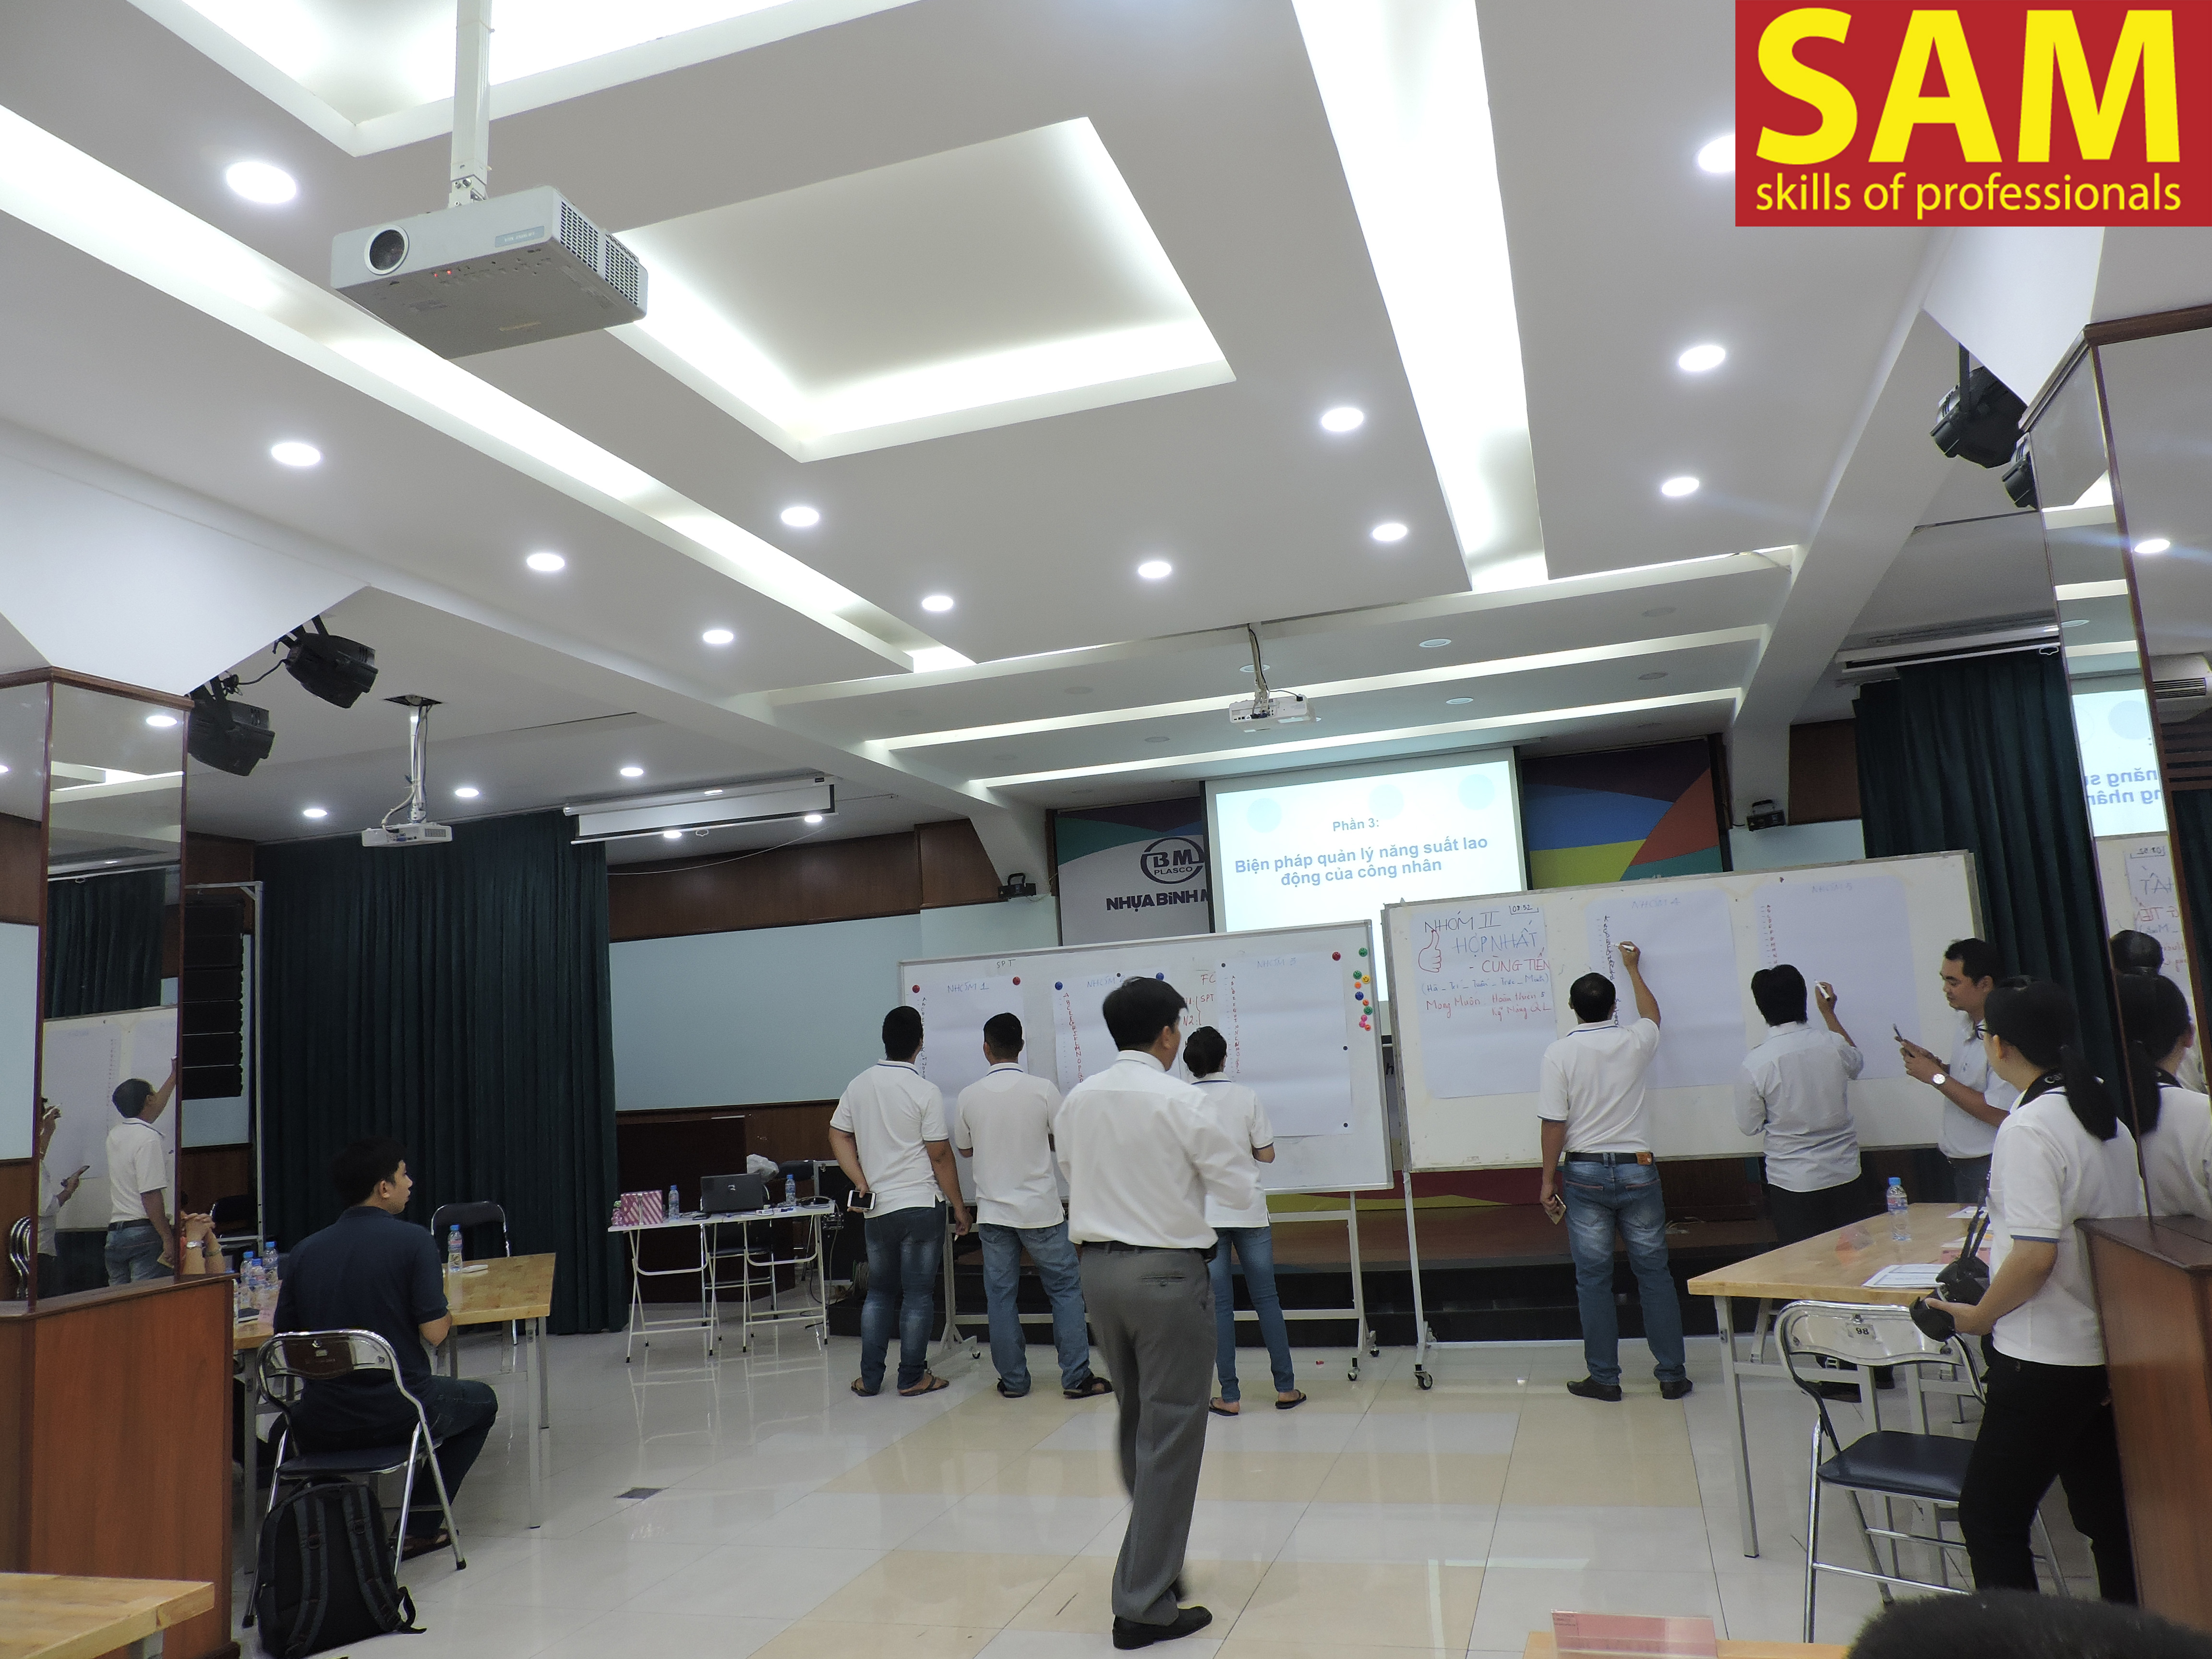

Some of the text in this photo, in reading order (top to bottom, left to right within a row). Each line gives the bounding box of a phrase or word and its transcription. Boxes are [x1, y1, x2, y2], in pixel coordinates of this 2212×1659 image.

[1333, 817, 1380, 831] Phần 3:
[1235, 836, 1488, 874] Biện pháp quản lý năng suất lao
[1154, 866, 1193, 876] PLASCO
[1281, 859, 1442, 888] động của công nhân
[1106, 894, 1155, 912] NHỰA
[1424, 911, 1474, 933] NHÓM
[1478, 911, 1502, 929] II
[996, 959, 1016, 968] SPT
[1200, 994, 1214, 1002] SPT
[1426, 1000, 1451, 1019] Mong
[1855, 1327, 1869, 1335] 98
